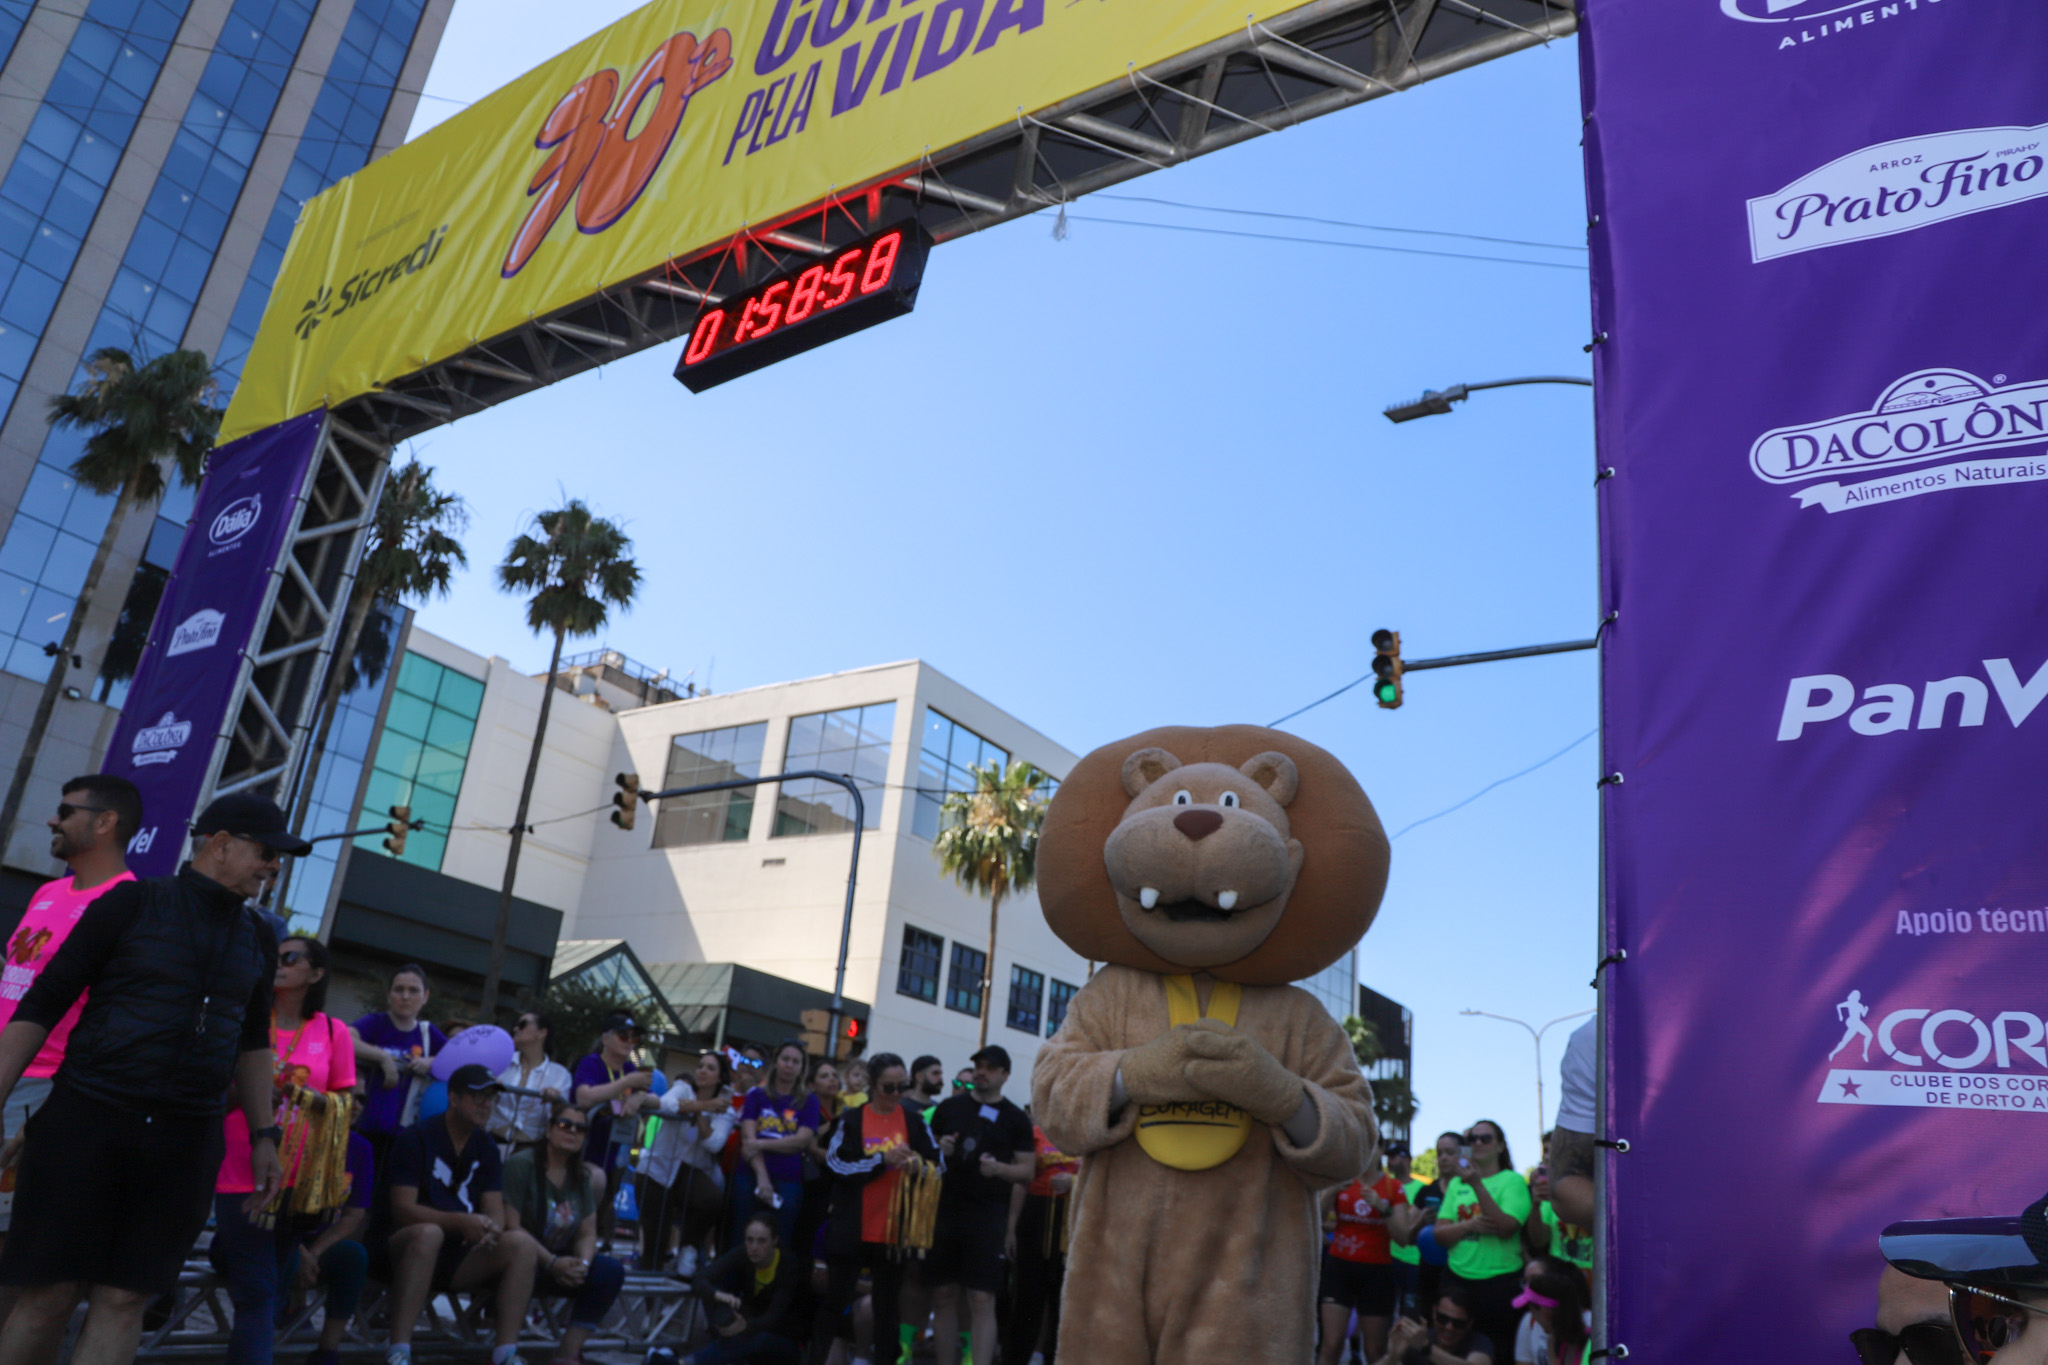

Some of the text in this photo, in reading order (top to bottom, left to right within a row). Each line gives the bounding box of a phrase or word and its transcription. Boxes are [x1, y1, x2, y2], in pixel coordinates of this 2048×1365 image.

[1778, 0, 1942, 50] ALIMENT
[722, 59, 822, 166] PELA
[829, 0, 1045, 118] VIDA
[1869, 141, 2040, 173] ARROZ PIRAHY
[332, 224, 449, 318] Sicredi
[1844, 460, 2047, 505] Alimentos Naturais
[1777, 658, 2048, 741] PanV
[1896, 908, 1972, 936] Apoio
[1877, 1008, 2048, 1069] COR
[1890, 1074, 2048, 1093] CLUBE DOS COR
[1926, 1091, 1952, 1105] DE
[1957, 1093, 2026, 1109] PORTO
